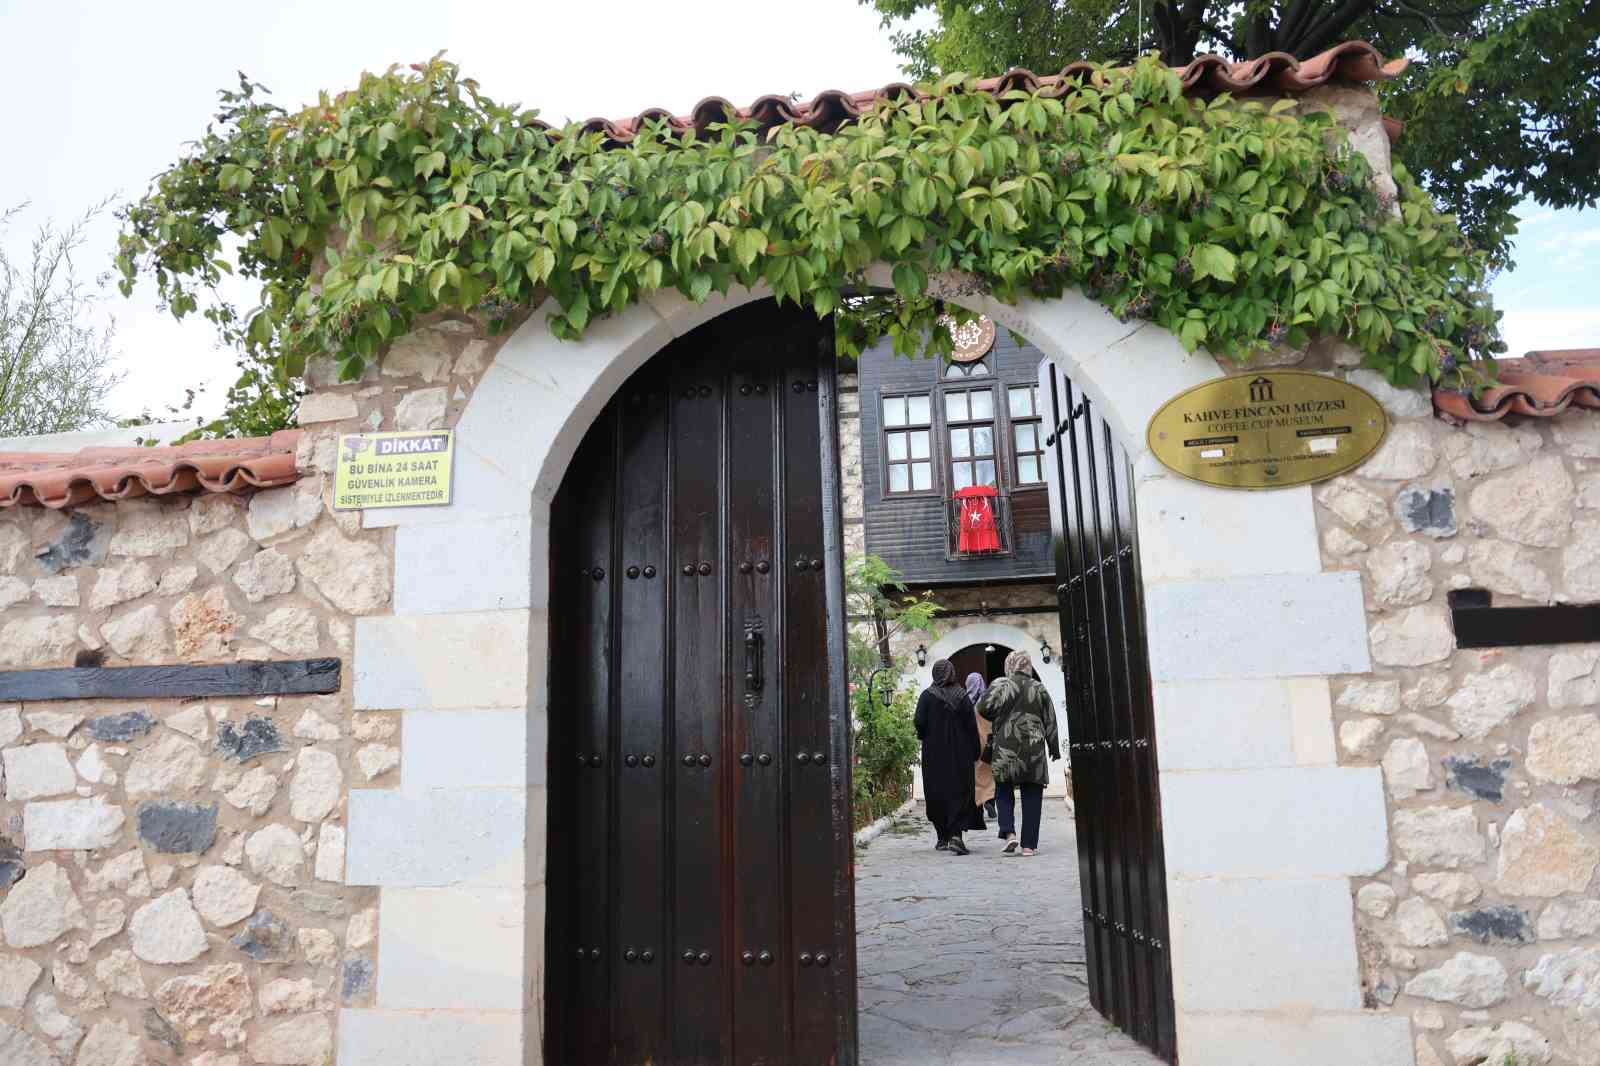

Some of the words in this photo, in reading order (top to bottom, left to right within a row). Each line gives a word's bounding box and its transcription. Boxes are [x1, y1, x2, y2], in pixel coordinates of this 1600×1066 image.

[1184, 406, 1233, 424] KAHVE
[382, 438, 443, 454] DİKKAT
[350, 464, 364, 475] BU
[368, 461, 393, 474] BİNA
[396, 461, 408, 473] 24
[411, 459, 439, 472] SAAT
[347, 477, 395, 490] GÜVENLİK
[398, 475, 438, 487] KAMERA
